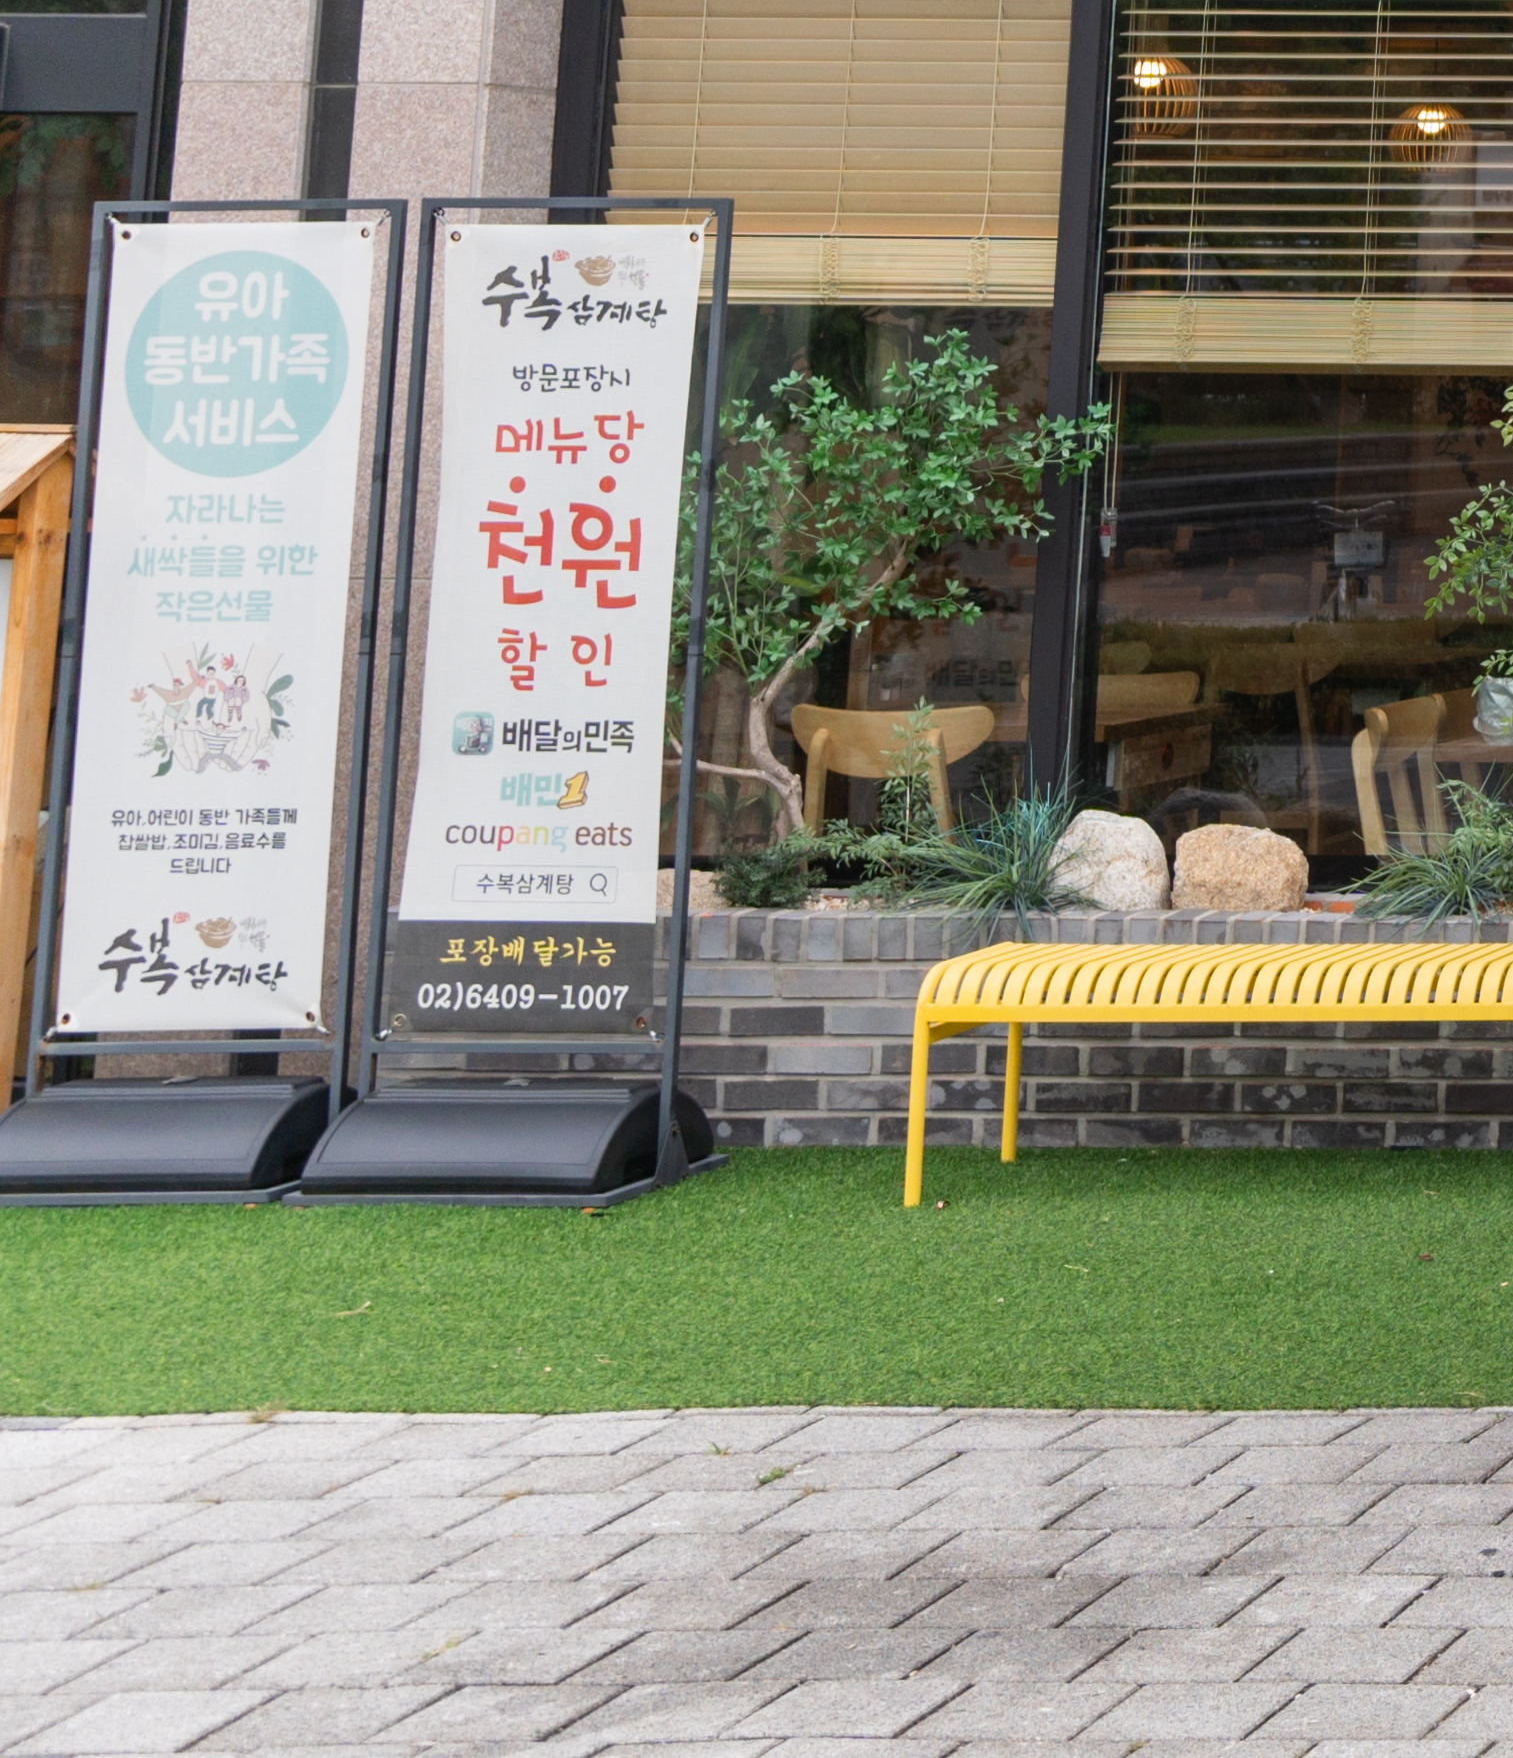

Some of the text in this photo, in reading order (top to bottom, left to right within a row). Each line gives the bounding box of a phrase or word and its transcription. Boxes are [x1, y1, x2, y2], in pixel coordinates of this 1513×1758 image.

[193, 271, 290, 323] 유아
[481, 255, 562, 331] 수복
[566, 294, 668, 329] 삼계탕
[143, 333, 331, 386] 동반가족
[512, 363, 631, 393] 방문포장시
[163, 397, 300, 448] 서비스
[495, 410, 645, 465] 메뉴당
[165, 493, 286, 525] 자라나는
[126, 543, 319, 578] 새싹들을 위한
[479, 501, 641, 609] 천원
[155, 589, 274, 623] 작은선물
[501, 718, 636, 754] 배달의민족
[500, 770, 590, 810] 배민1
[198, 808, 231, 826] 동반
[235, 808, 298, 826] 가족들께
[444, 822, 634, 854] coupang eats
[169, 856, 232, 875] 드립니다
[476, 872, 574, 895] 수복삼계탕
[99, 916, 179, 996] 수복
[183, 956, 288, 992] 삼계탕
[439, 935, 618, 969] 포장배달가능
[416, 981, 630, 1013] 02)6409-1007
